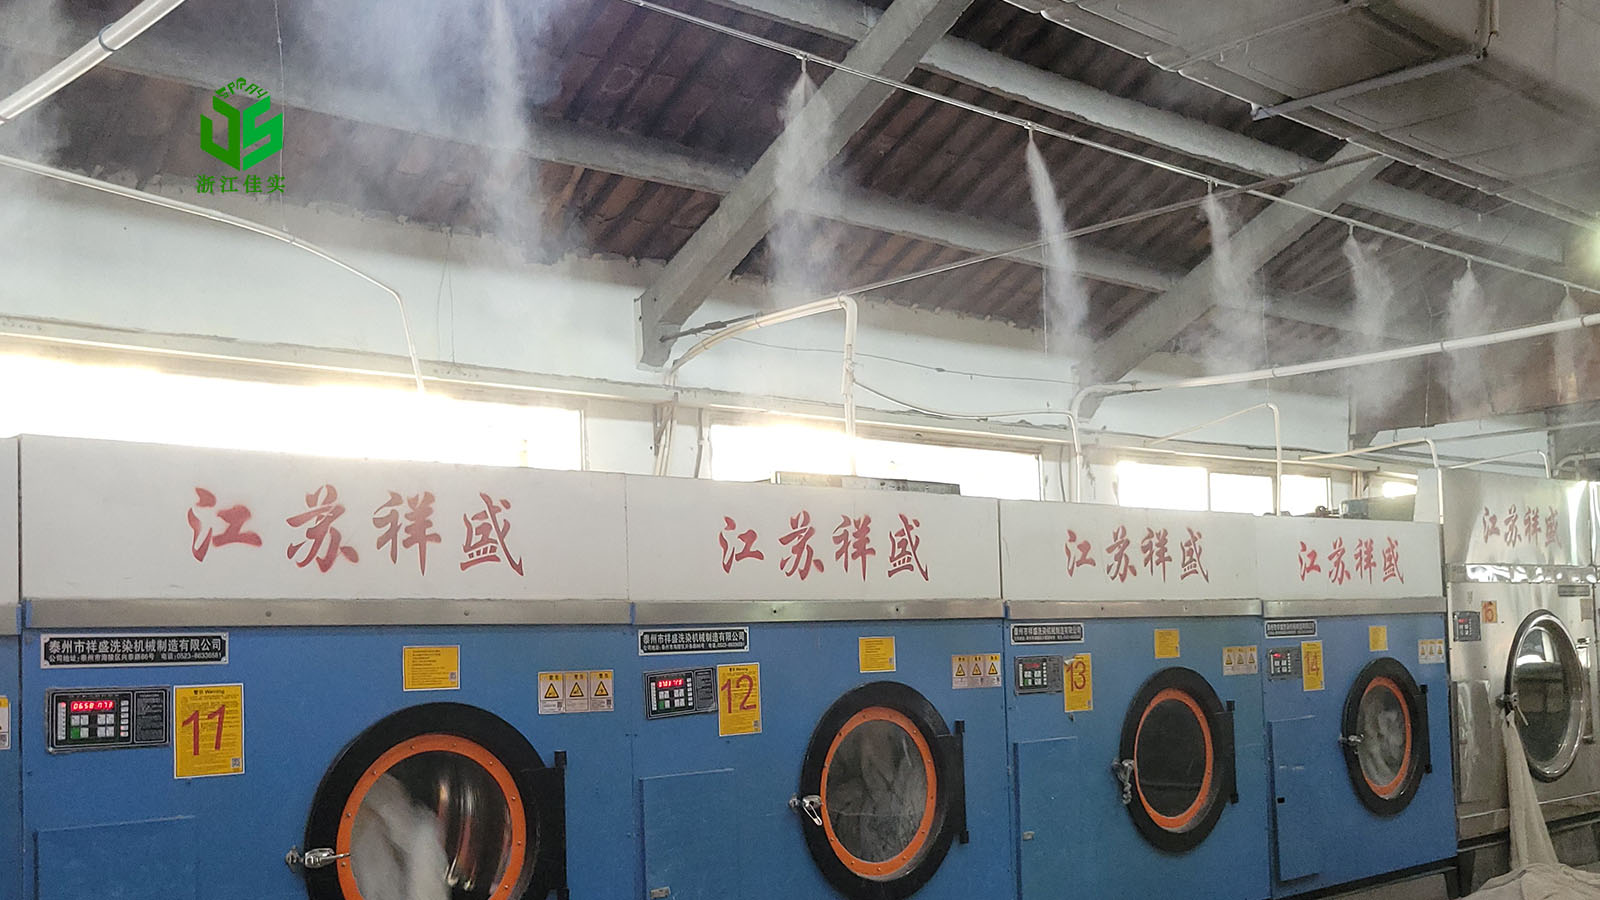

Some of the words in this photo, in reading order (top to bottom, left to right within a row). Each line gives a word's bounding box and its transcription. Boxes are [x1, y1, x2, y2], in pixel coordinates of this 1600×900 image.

[187, 485, 524, 576] 江苏祥盛
[719, 510, 929, 581] 江苏祥盛
[1482, 504, 1562, 549] 江苏祥盛
[1065, 526, 1209, 583] 江苏祥盛
[1298, 537, 1405, 586] 江苏祥盛
[48, 638, 222, 653] 泰州市祥盛洗染机械制造有限公司
[721, 674, 757, 714] 12
[1066, 661, 1088, 693] 13
[182, 704, 226, 757] 11
